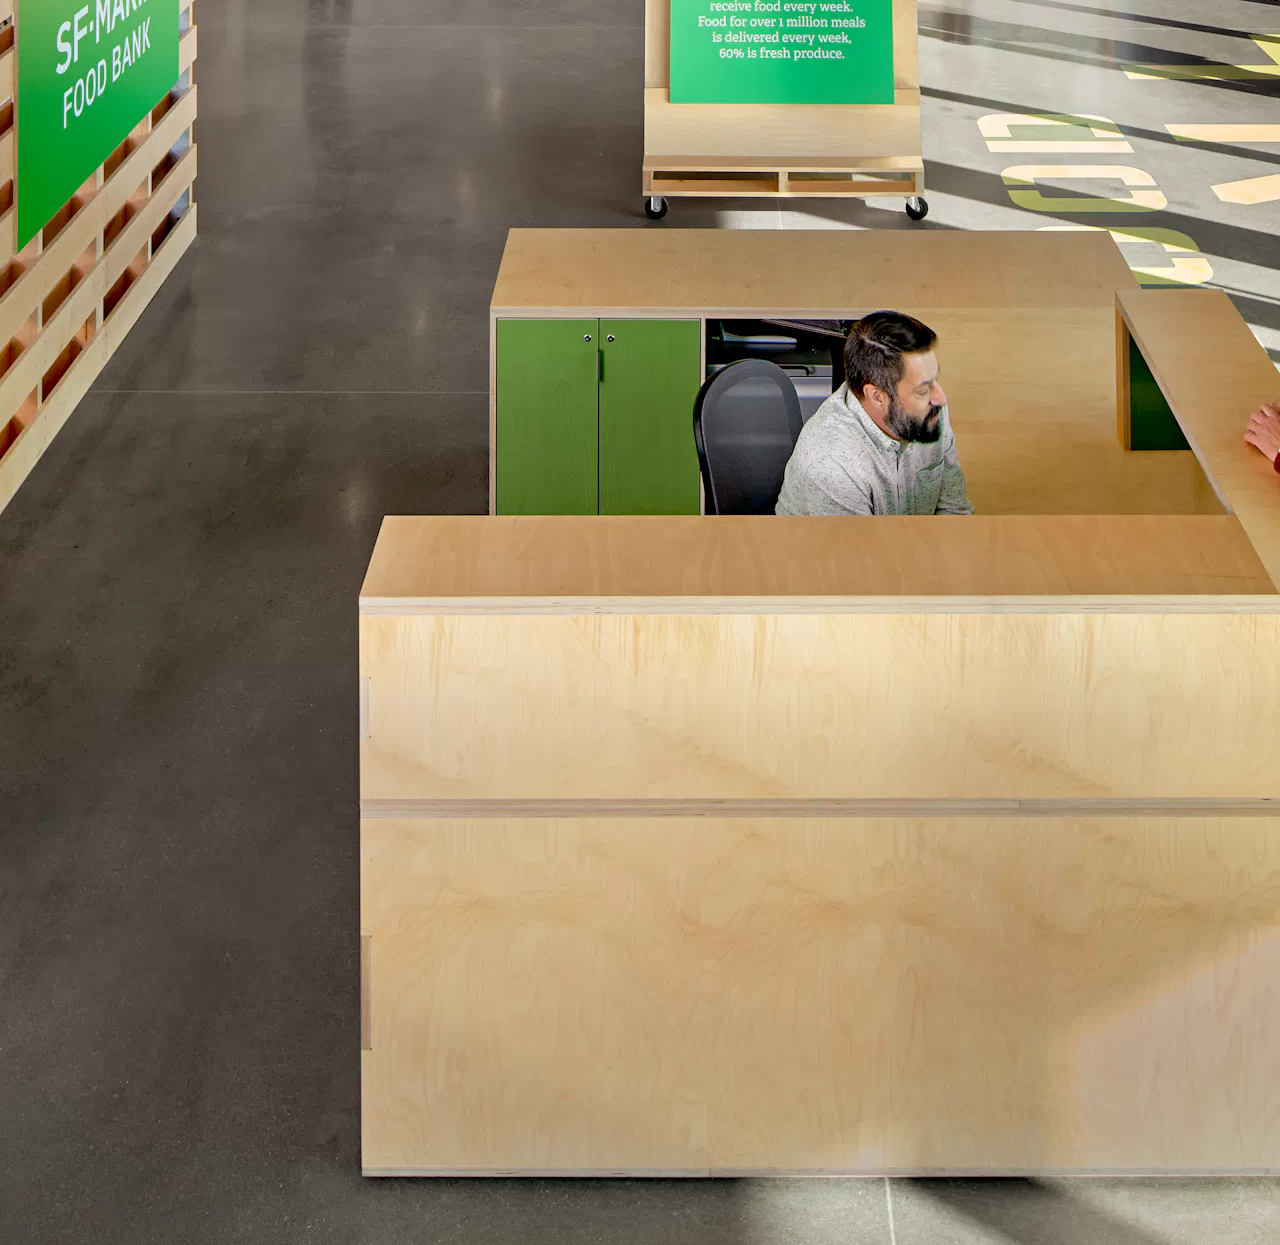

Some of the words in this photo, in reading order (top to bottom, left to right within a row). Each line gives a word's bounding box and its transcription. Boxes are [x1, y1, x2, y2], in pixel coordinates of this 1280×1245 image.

[710, 1, 751, 12] receive
[754, 1, 780, 12] food
[783, 4, 816, 15] every
[819, 1, 853, 12] week.
[698, 16, 727, 27] Food
[730, 16, 747, 27] for
[750, 19, 775, 27] over
[778, 18, 783, 27] 1
[786, 16, 828, 27] million
[831, 16, 865, 27] meals
[712, 32, 721, 42] is
[725, 31, 779, 42] delivered
[782, 34, 816, 45] every
[818, 31, 851, 45] week,
[719, 47, 744, 58] 60%
[747, 48, 756, 58] is
[760, 47, 791, 58] fresh
[794, 47, 844, 61] produce.
[64, 59, 106, 129] FOOD
[112, 16, 151, 82] BANK
